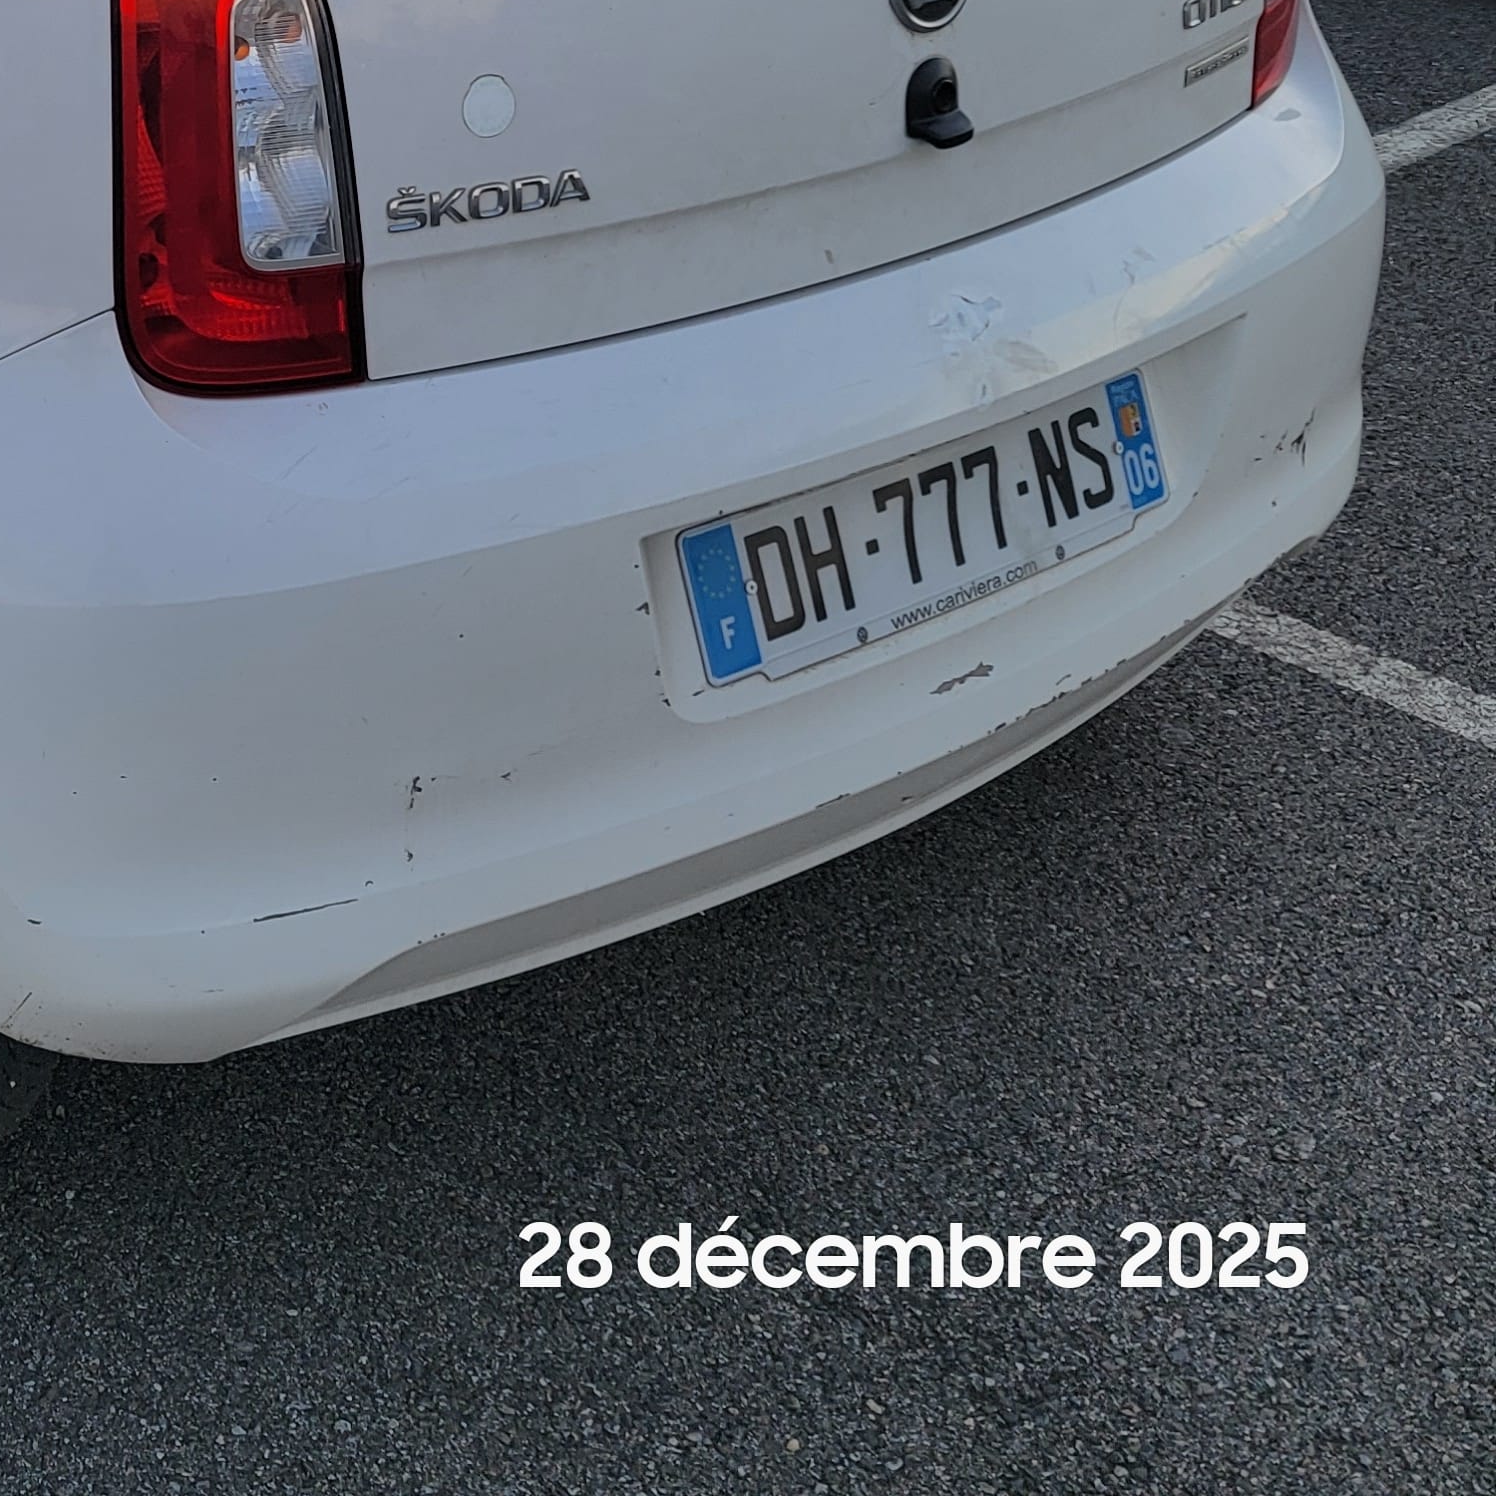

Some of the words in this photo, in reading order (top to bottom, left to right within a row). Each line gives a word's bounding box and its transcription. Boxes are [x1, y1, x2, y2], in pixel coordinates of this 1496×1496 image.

[385, 168, 591, 233] ŠKODA
[1124, 443, 1160, 496] 06
[890, 559, 1039, 630] www.cariviera.com
[720, 616, 735, 650] F
